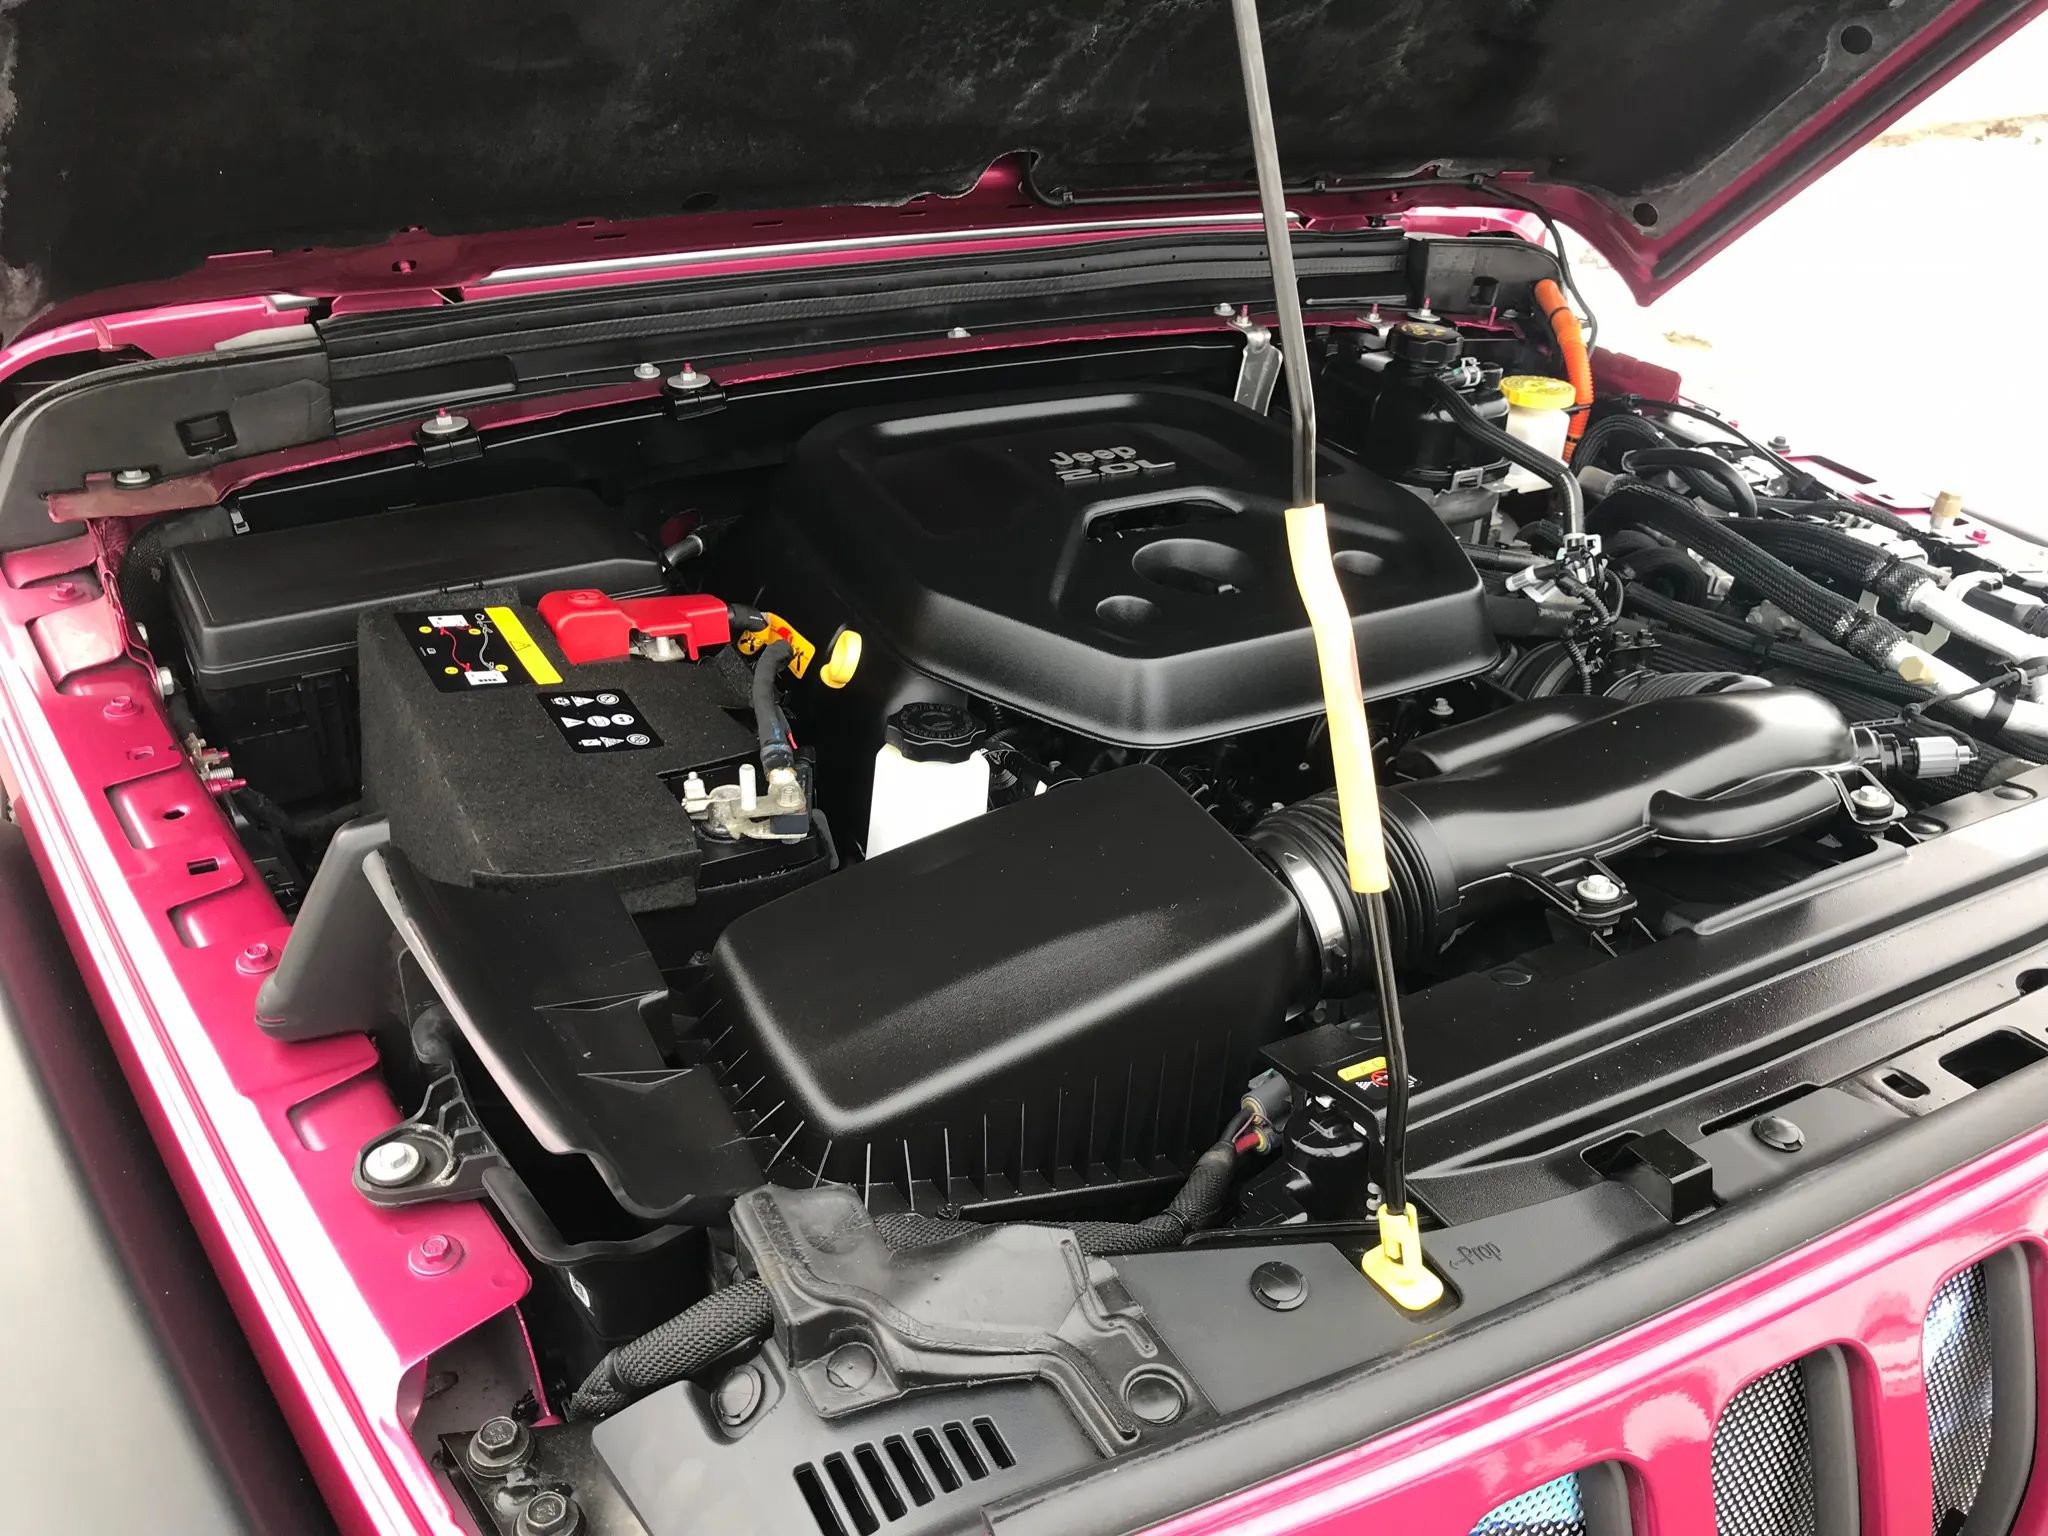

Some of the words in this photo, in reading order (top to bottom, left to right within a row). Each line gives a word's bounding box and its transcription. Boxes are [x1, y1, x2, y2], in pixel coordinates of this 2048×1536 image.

[1049, 446, 1137, 467] Jeep
[1056, 459, 1176, 482] 2.0L
[1456, 1241, 1502, 1265] Prop
